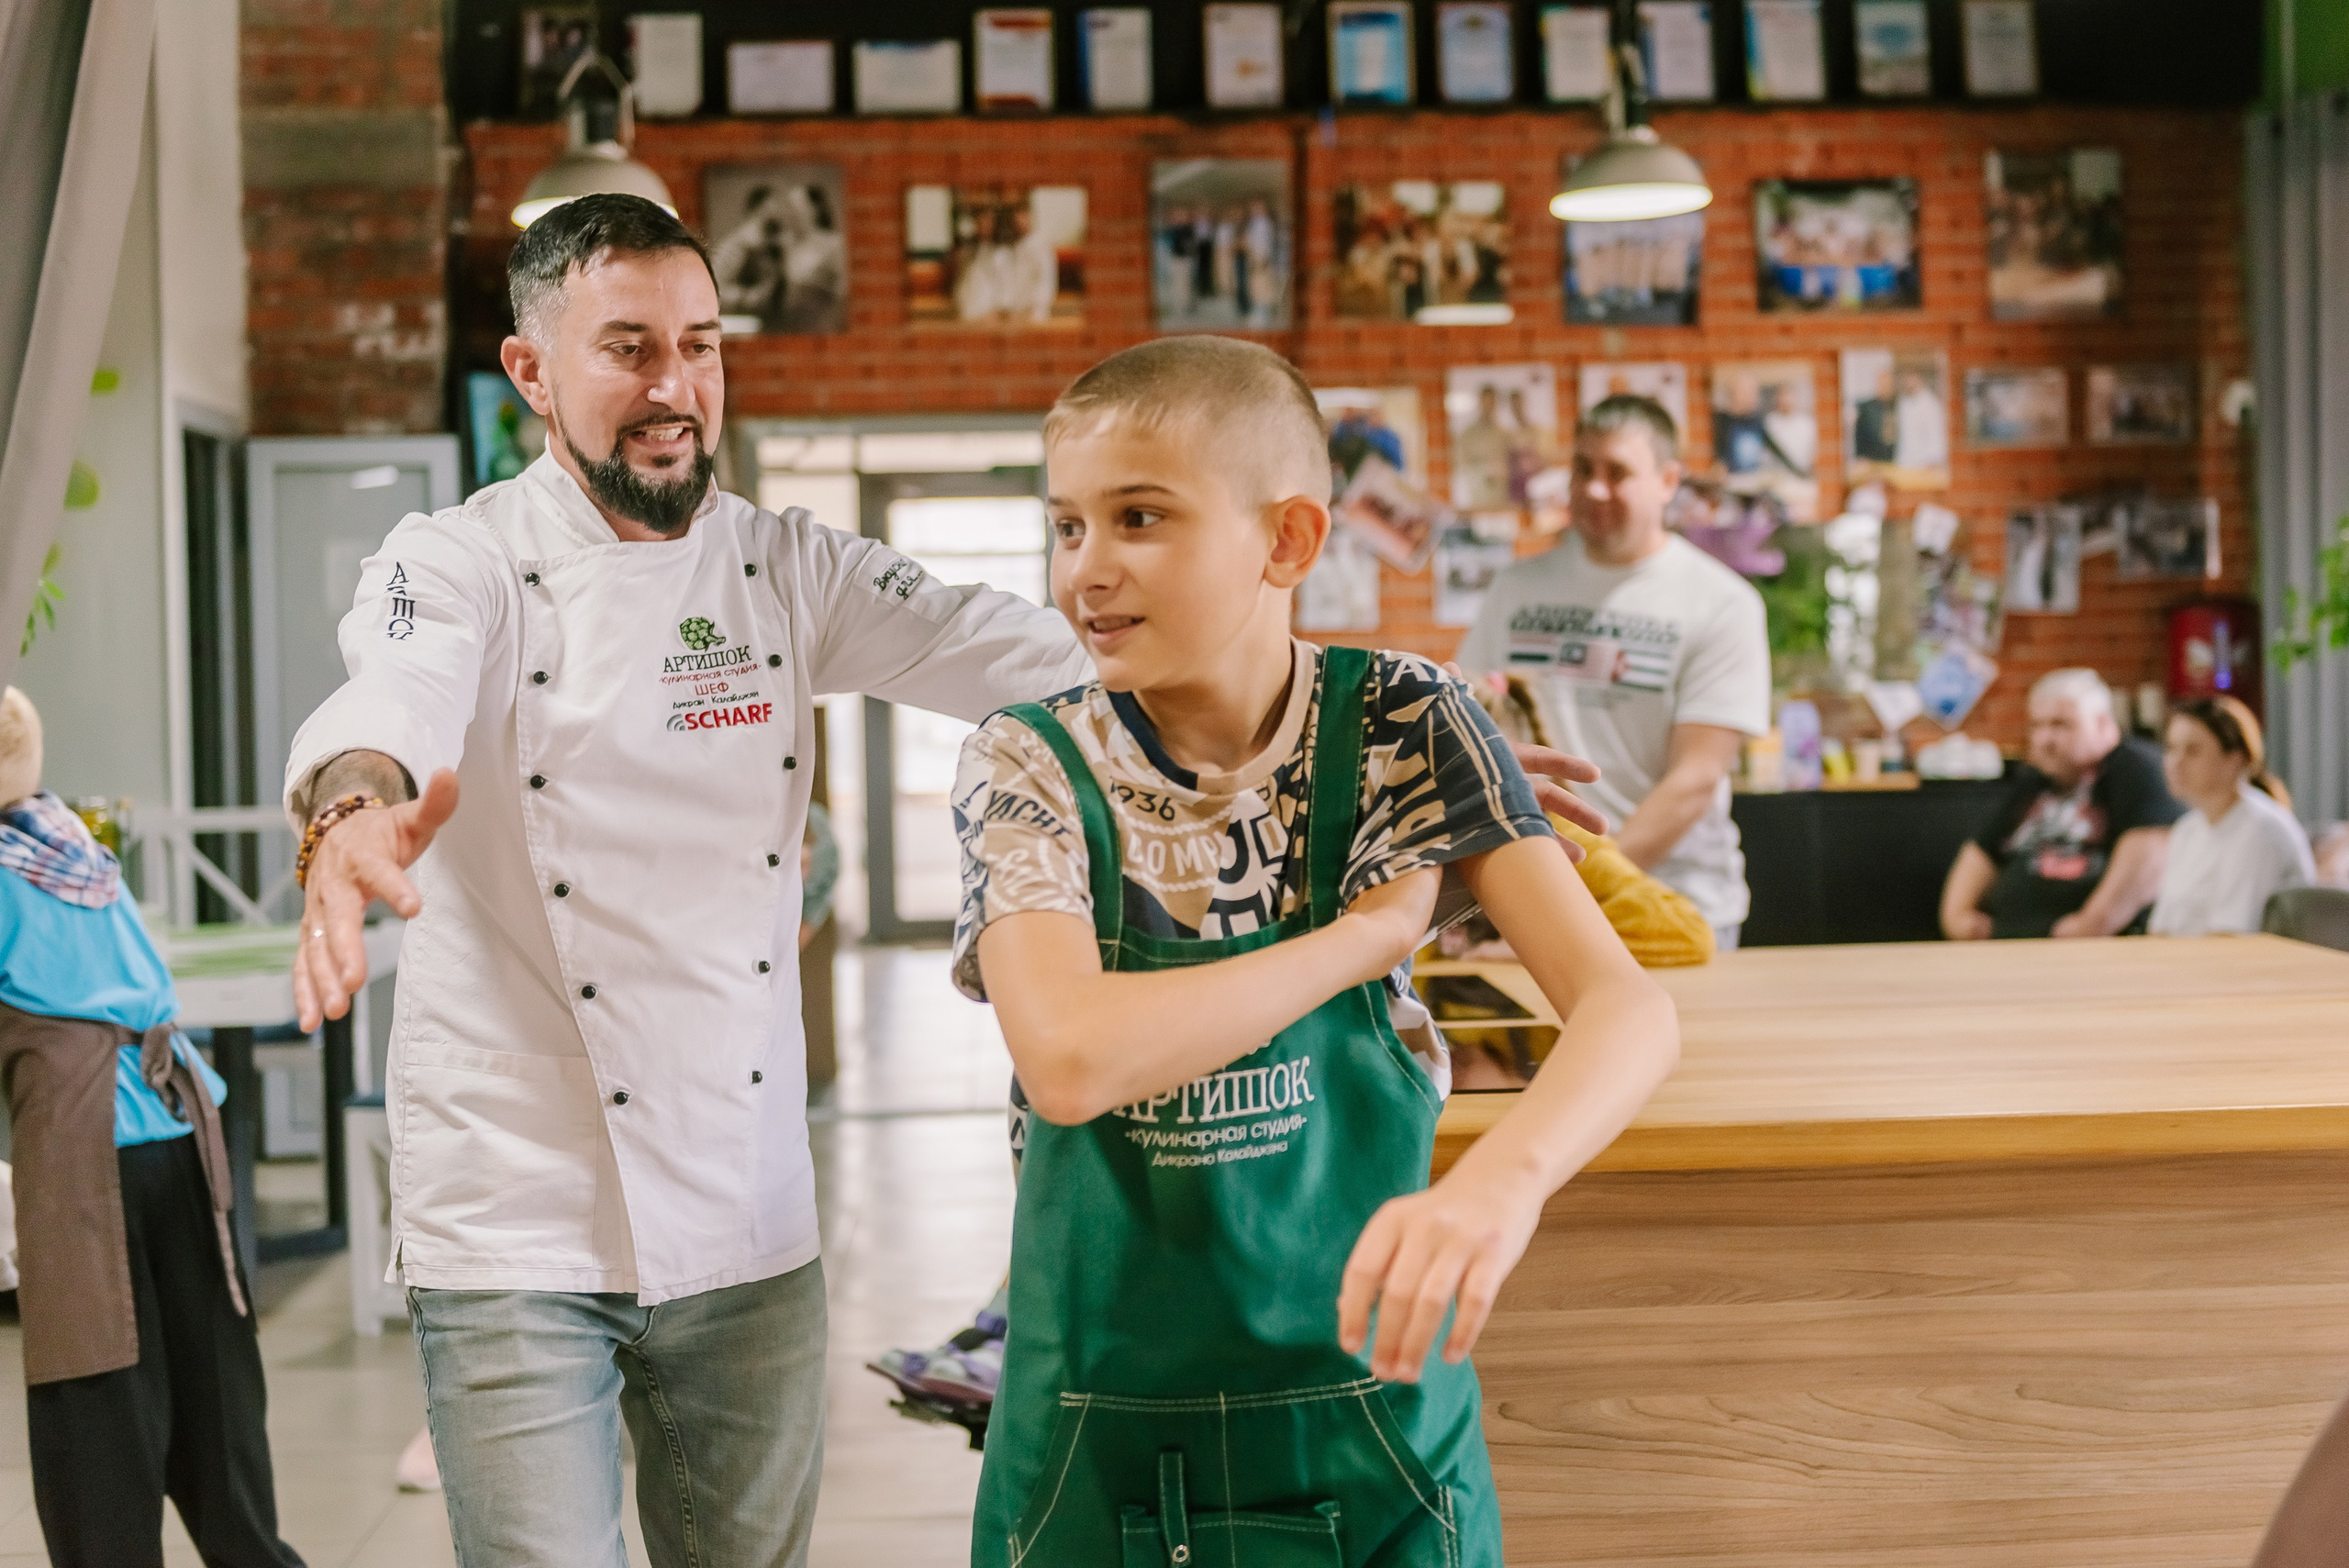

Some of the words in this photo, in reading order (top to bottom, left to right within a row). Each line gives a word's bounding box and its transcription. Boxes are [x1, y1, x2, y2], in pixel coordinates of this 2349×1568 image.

[662, 644, 752, 673] АРТИШОК
[694, 681, 729, 696] ШЕФ
[685, 702, 773, 730] SCHARF
